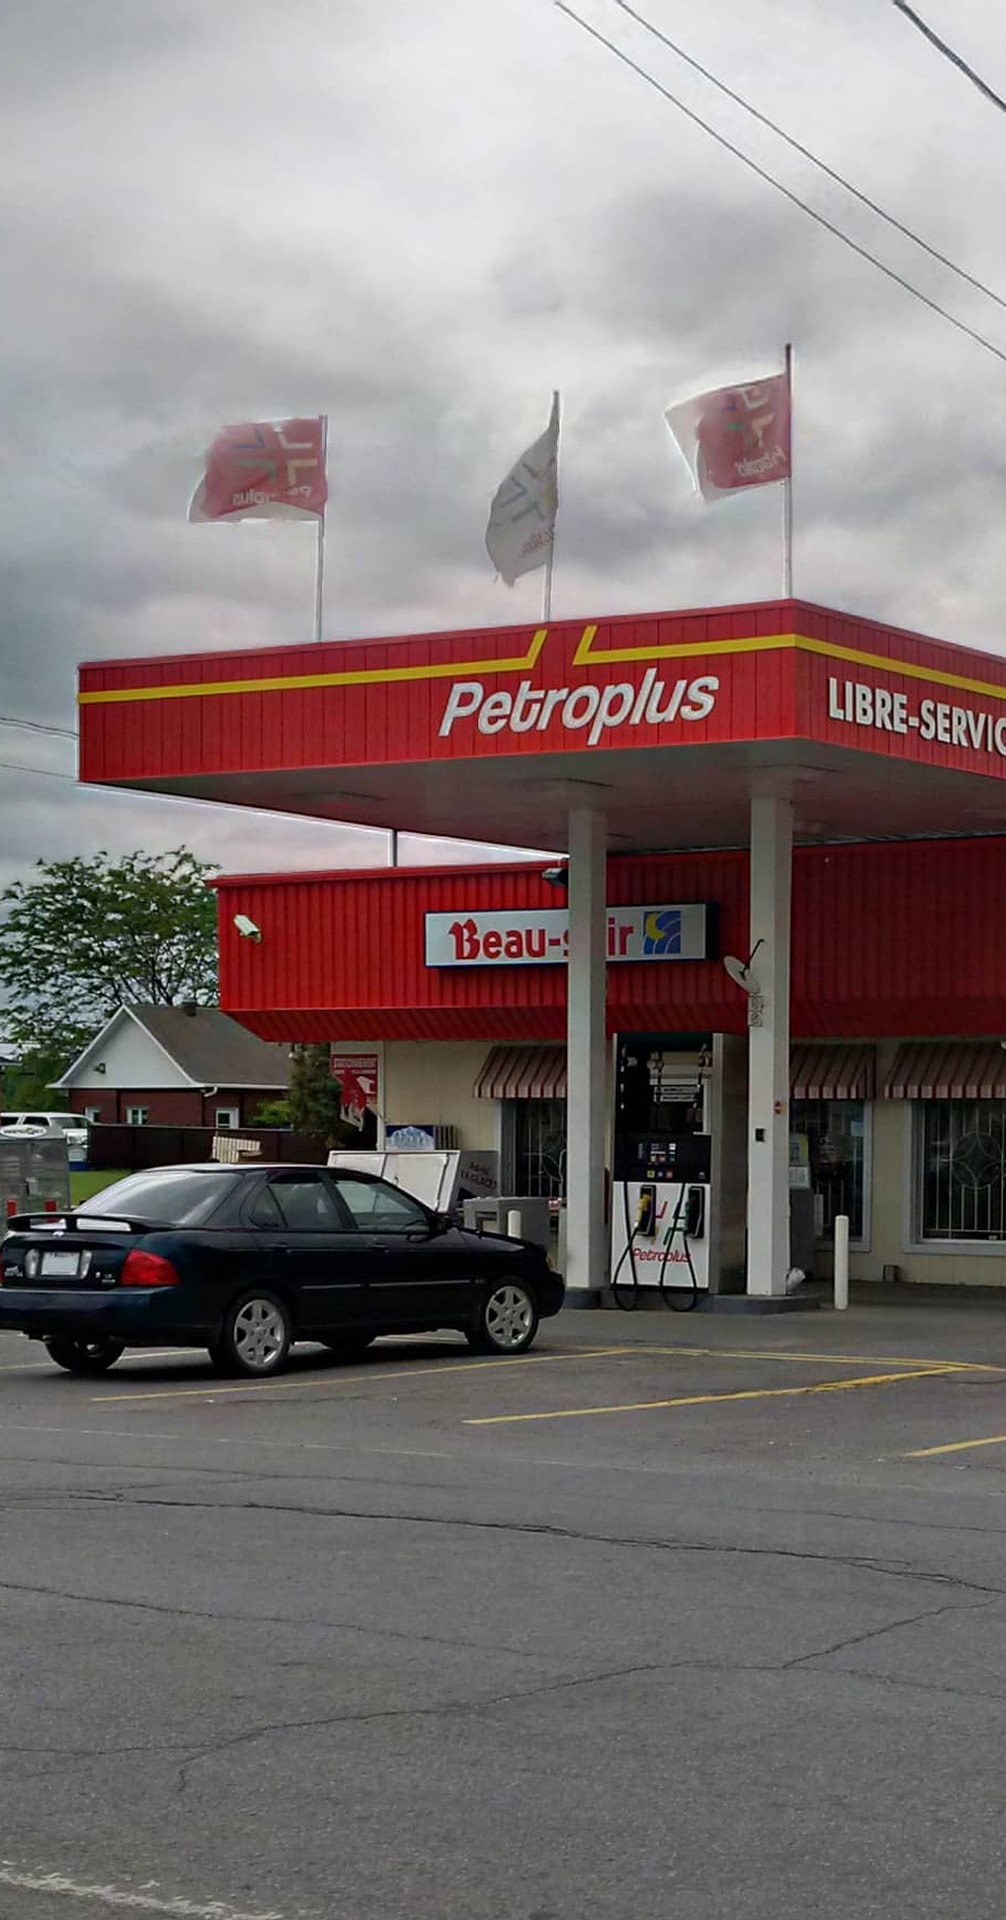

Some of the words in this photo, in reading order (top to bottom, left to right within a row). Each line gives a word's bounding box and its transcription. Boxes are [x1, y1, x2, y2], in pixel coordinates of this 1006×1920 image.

[438, 667, 720, 746] Petroplus
[828, 676, 1006, 757] LIBRE-SERVIC
[449, 917, 634, 960] Beau-ir
